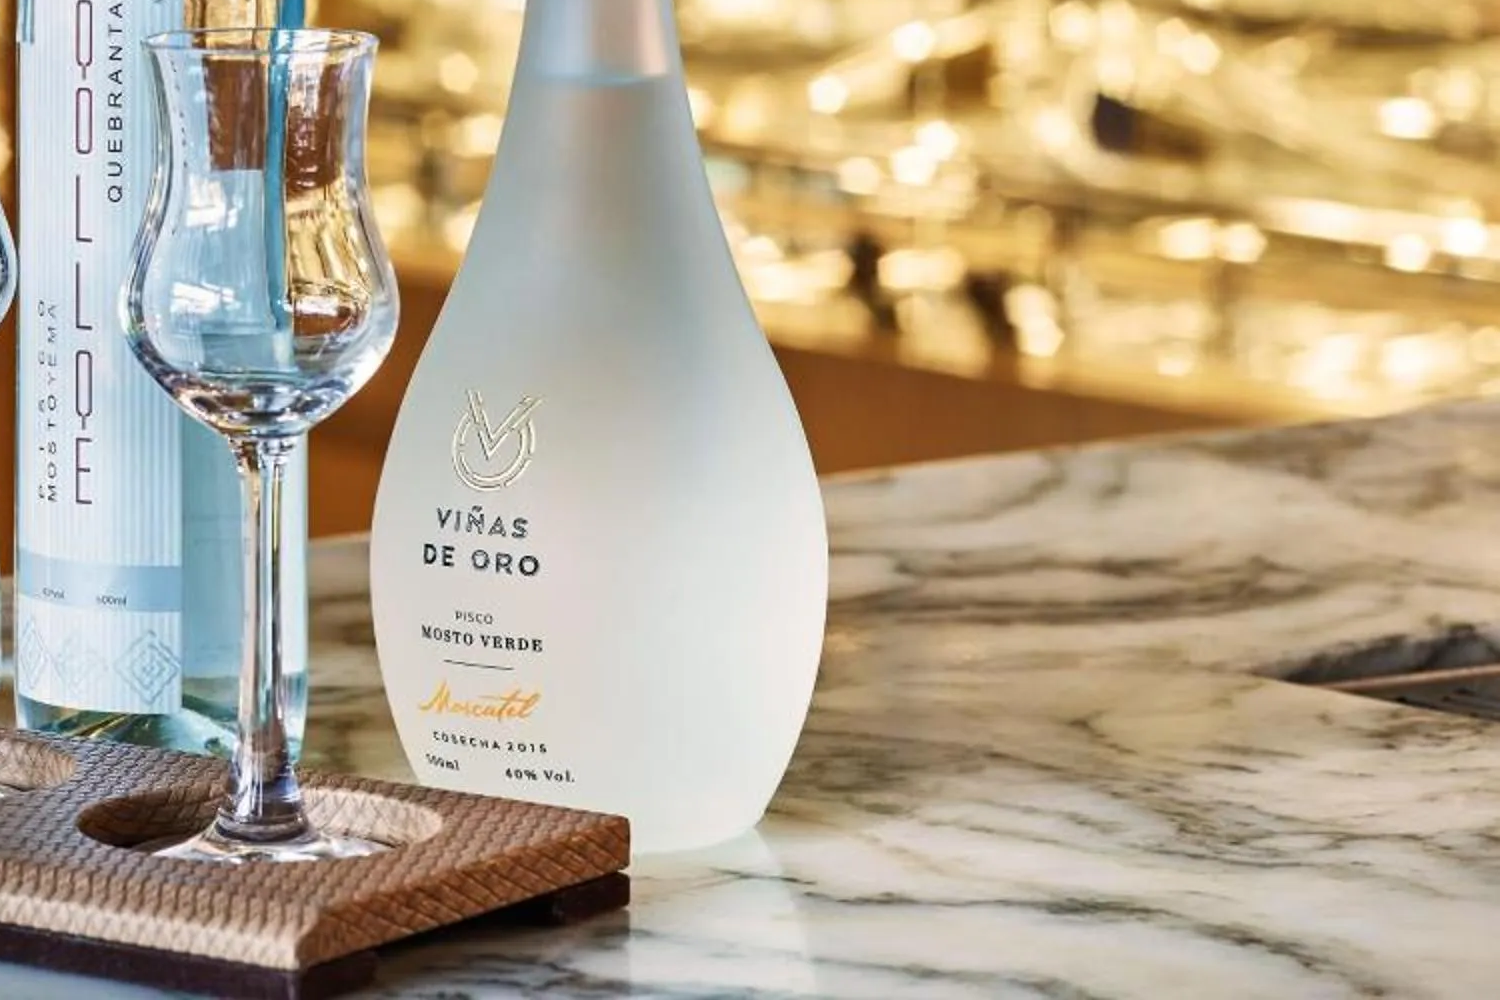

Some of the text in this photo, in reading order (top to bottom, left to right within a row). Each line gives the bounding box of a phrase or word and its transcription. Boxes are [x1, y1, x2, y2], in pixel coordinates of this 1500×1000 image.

[107, 2, 124, 203] QUEBRANTA
[437, 505, 529, 539] VIÑAS
[423, 543, 540, 577] DE ORO
[455, 610, 493, 625] PISCO
[421, 624, 543, 653] MOSTO VERDE
[432, 730, 548, 754] COSECHA 2015
[505, 767, 576, 784] 40% Vol.
